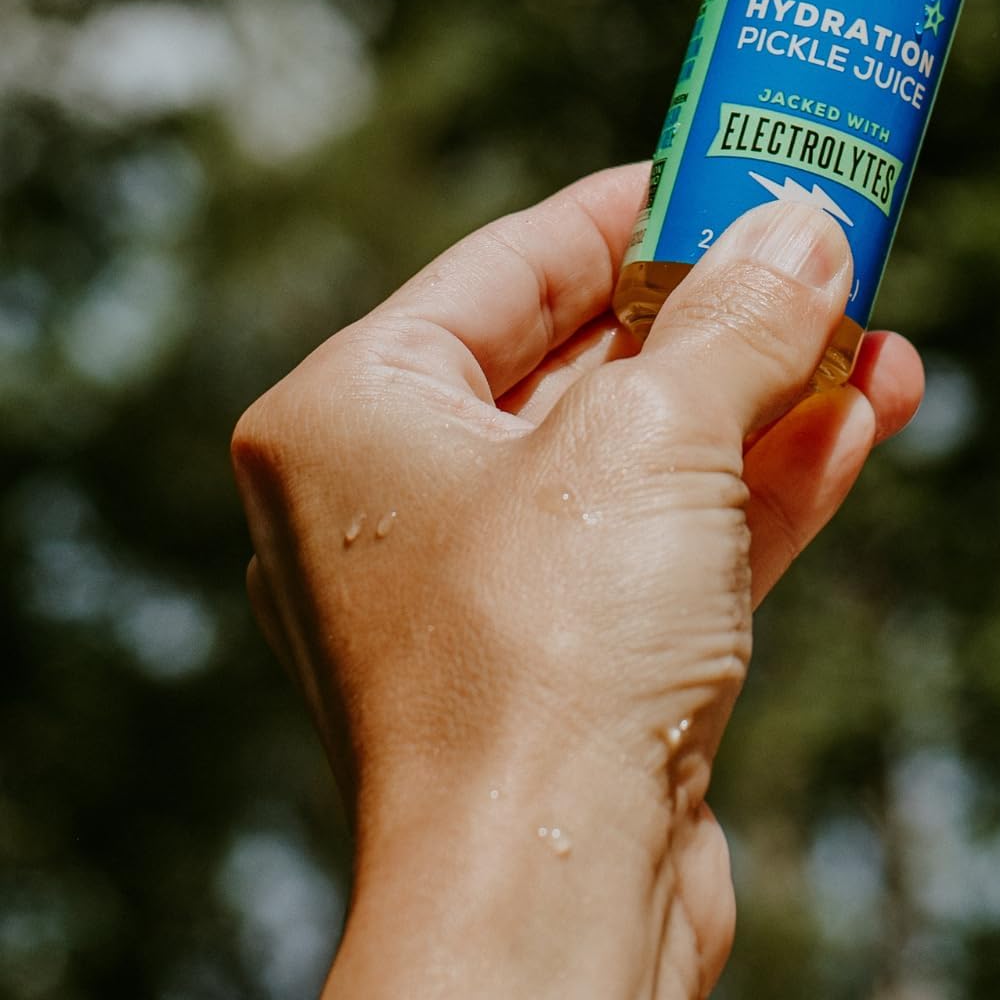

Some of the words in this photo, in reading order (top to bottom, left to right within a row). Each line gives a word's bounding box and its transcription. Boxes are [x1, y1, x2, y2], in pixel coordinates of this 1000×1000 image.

[736, 25, 846, 73] PICKLE
[853, 50, 927, 111] JUICE
[720, 111, 897, 206] ELECTROLYTES
[757, 88, 841, 122] JACKED
[847, 111, 891, 144] WITH
